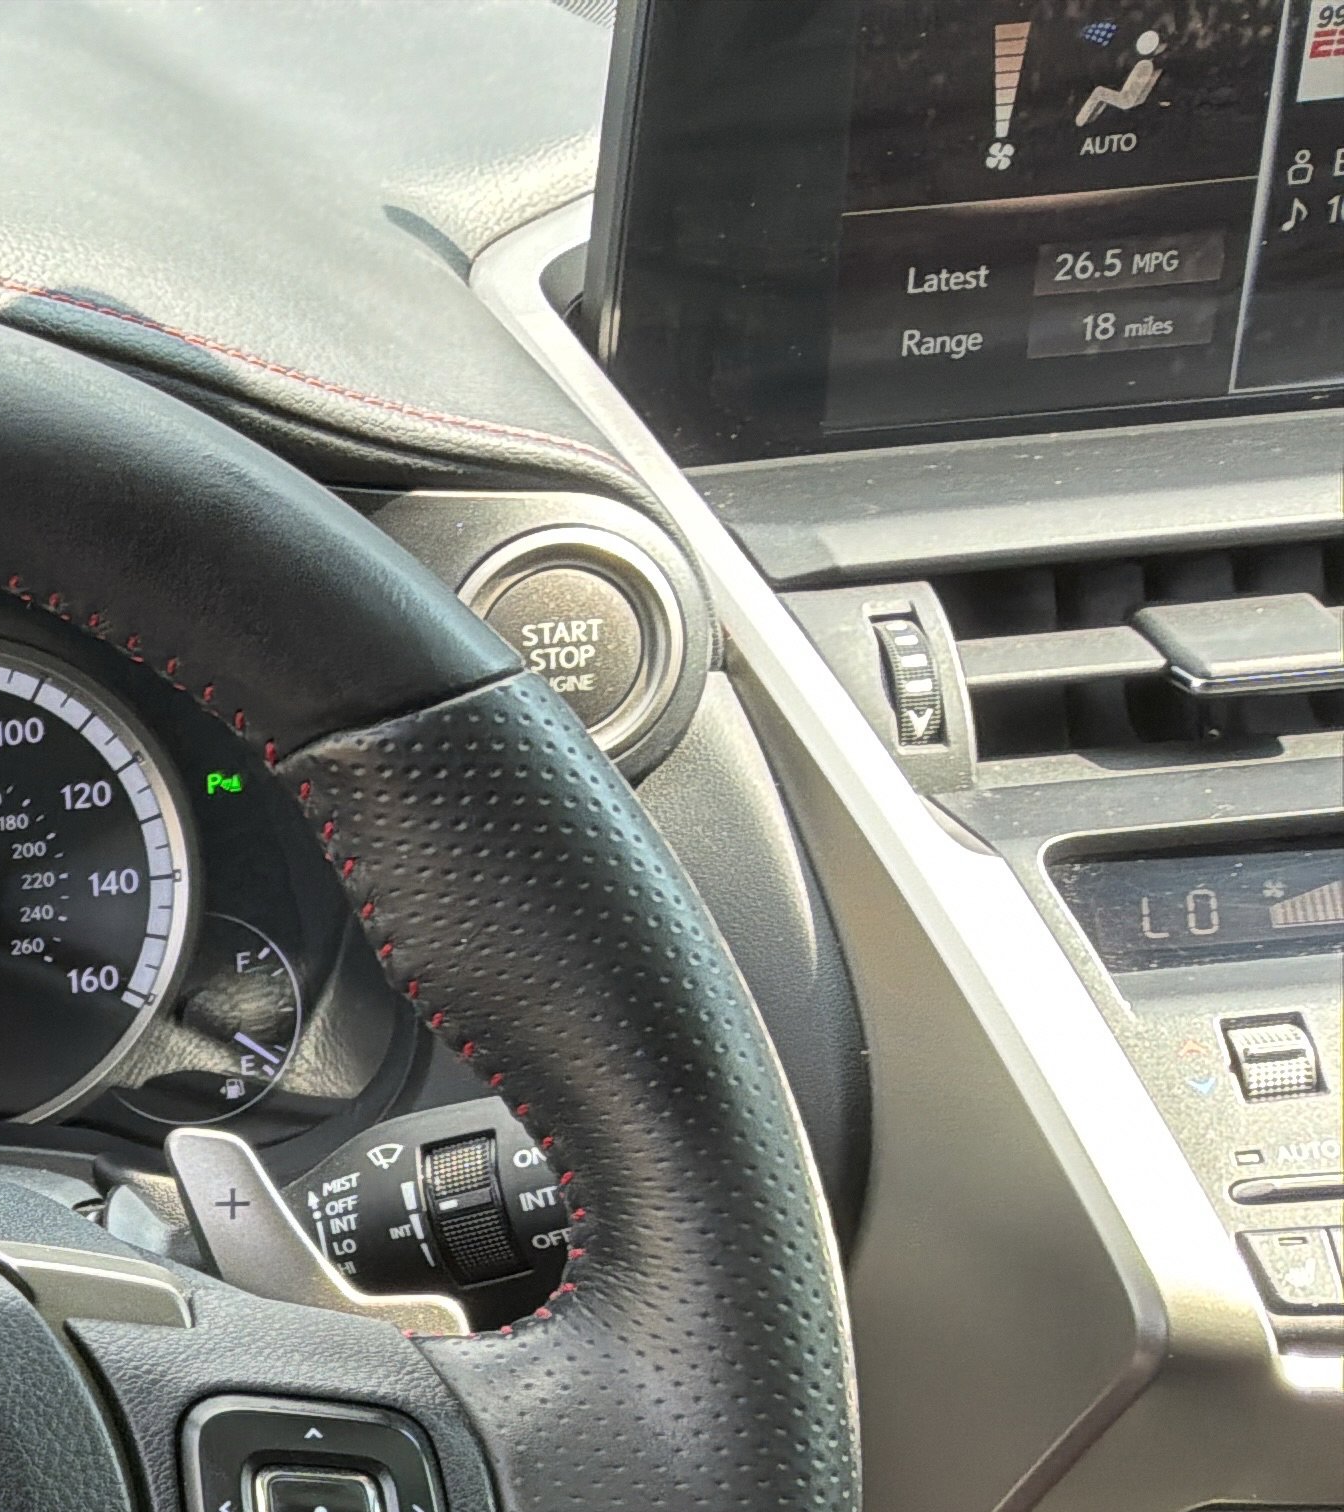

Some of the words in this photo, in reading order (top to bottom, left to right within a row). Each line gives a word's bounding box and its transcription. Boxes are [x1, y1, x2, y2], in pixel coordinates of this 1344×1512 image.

[1080, 133, 1137, 155] AUTO
[907, 266, 989, 294] Latest
[1054, 249, 1122, 281] 26.5
[1132, 250, 1179, 274] MPG
[902, 330, 983, 359] Range
[1083, 313, 1116, 340] 18
[1124, 316, 1173, 337] miles
[522, 619, 603, 647] START
[530, 646, 595, 671] STOP
[550, 673, 596, 693] GINE
[61, 781, 112, 809] 120
[0, 813, 29, 831] 180
[12, 841, 47, 859] 200
[22, 871, 56, 889] 220
[89, 868, 139, 896] 140
[21, 904, 54, 922] 240
[1141, 889, 1220, 940] LO
[11, 937, 45, 955] 260
[237, 952, 254, 973] F
[67, 965, 119, 993] 160
[237, 1055, 260, 1076] E
[322, 1173, 360, 1195] MIST
[325, 1196, 357, 1217] OFF
[518, 1185, 559, 1212] INT
[330, 1214, 358, 1235] INT
[389, 1225, 411, 1239] INT
[332, 1238, 357, 1256] LO
[532, 1226, 572, 1249] OFF
[336, 1260, 357, 1276] HI
